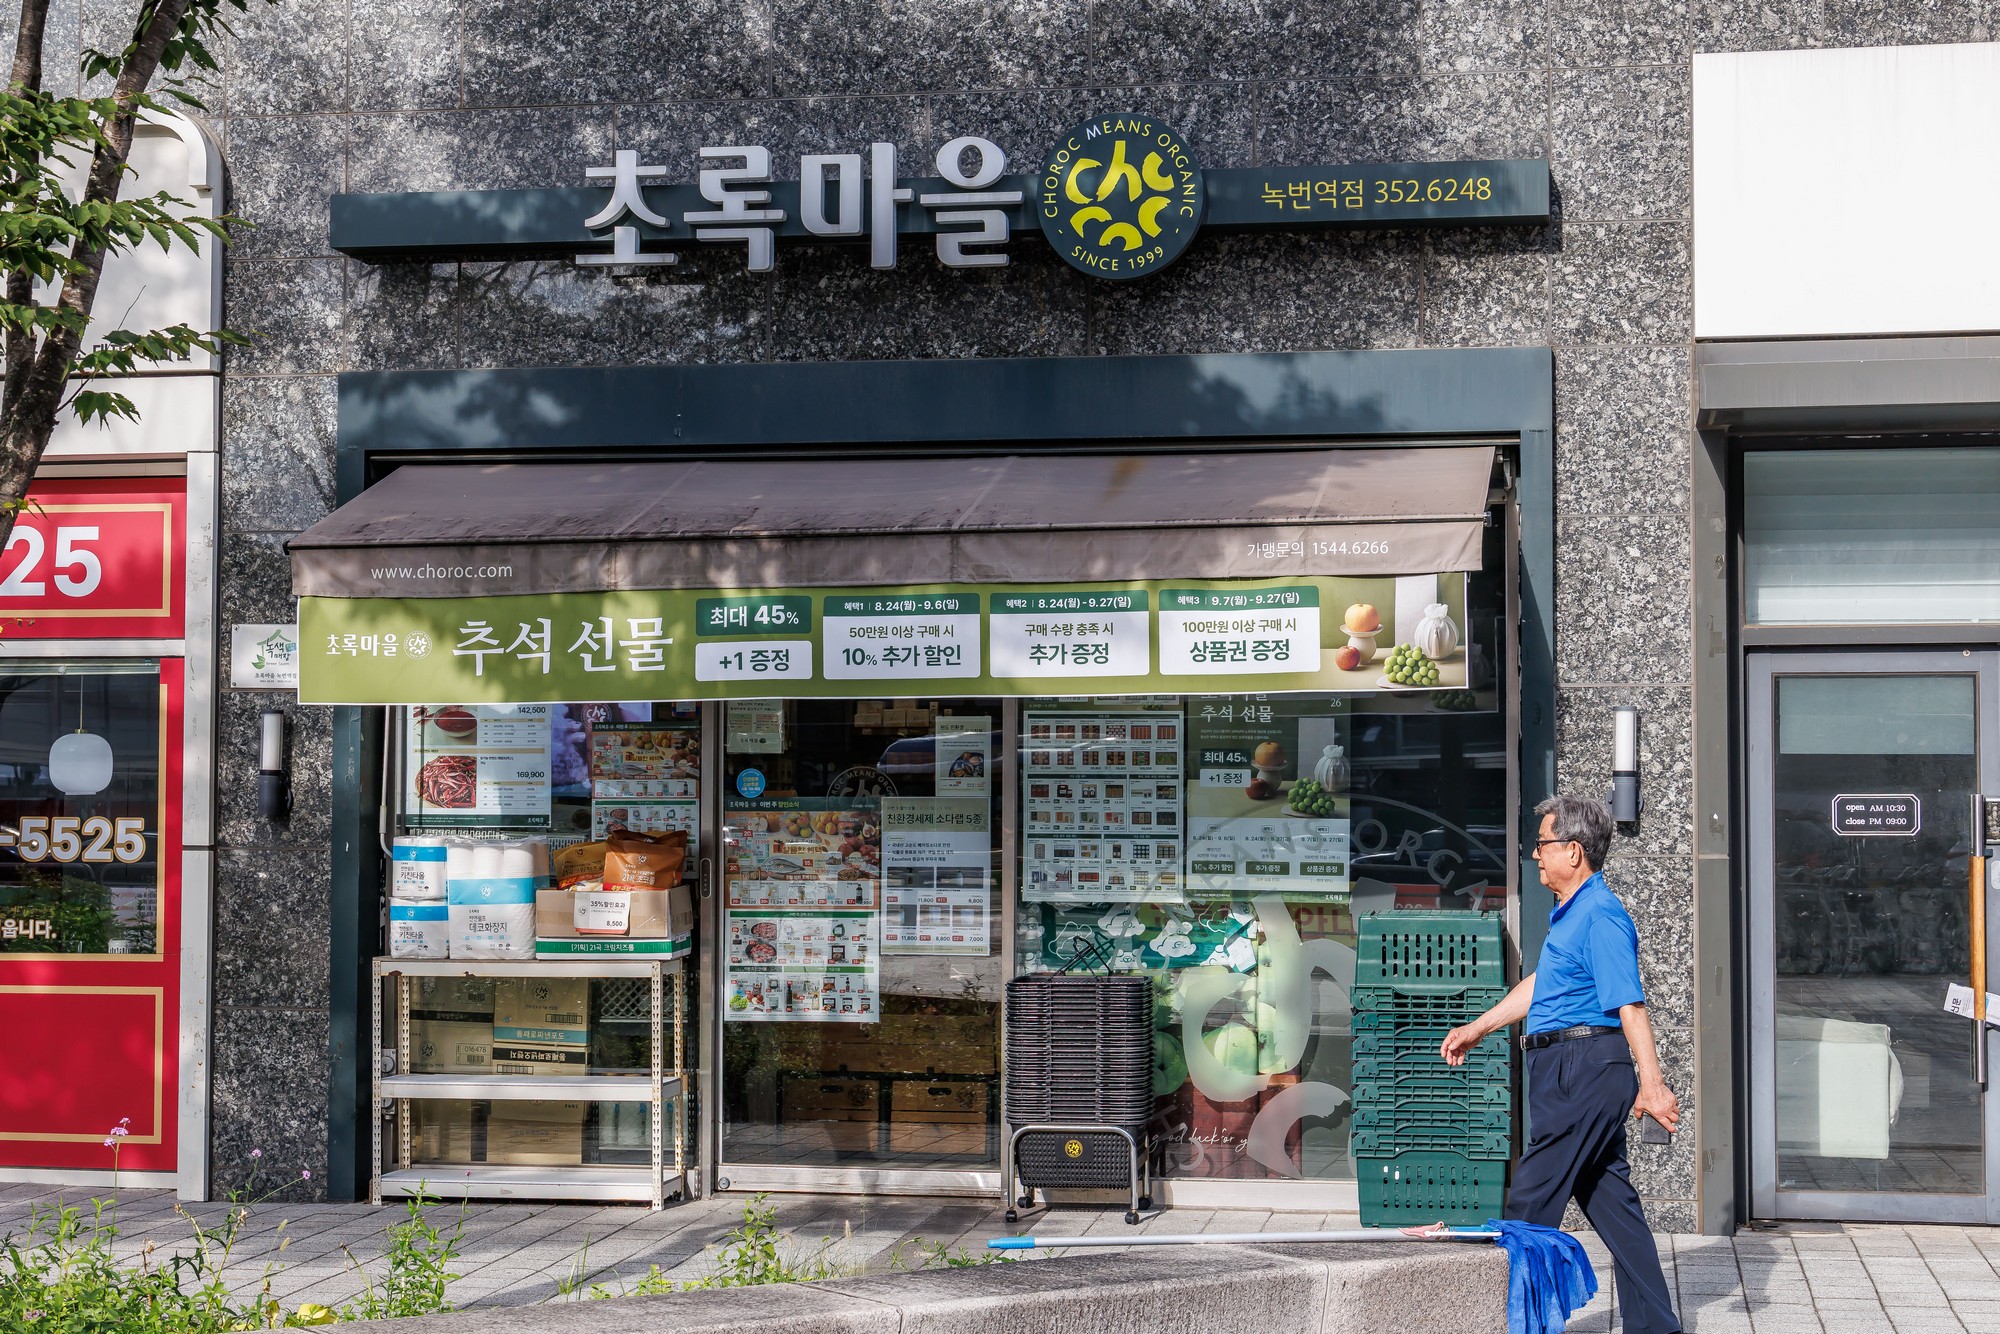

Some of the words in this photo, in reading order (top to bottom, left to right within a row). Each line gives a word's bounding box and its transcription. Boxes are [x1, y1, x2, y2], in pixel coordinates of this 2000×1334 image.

[1044, 138, 1080, 217] CHOROC
[1086, 119, 1152, 141] MEANS
[1158, 133, 1196, 218] ORGANIC
[1261, 179, 1364, 210] 녹번역점
[1374, 177, 1491, 204] 352.6248
[576, 136, 1023, 273] 초록마을
[1071, 245, 1119, 271] SINCE
[1128, 246, 1164, 270] 1999
[1247, 541, 1304, 559] 가맹문의
[1312, 540, 1389, 555] 1544.6266
[371, 562, 513, 579] www.choroc.com
[710, 606, 747, 628] 최대
[754, 604, 799, 625] 45%
[849, 626, 889, 639] 50만원
[891, 625, 914, 639] 이상
[917, 625, 941, 638] 구매
[943, 624, 954, 638] 시
[1025, 623, 1048, 637] 구매
[1050, 622, 1073, 637] 수량
[1076, 622, 1099, 636] 충족
[1102, 622, 1114, 636] 시
[1182, 619, 1229, 634] 100만원
[1232, 618, 1255, 633] 이상
[1258, 618, 1282, 633] 구매
[1285, 618, 1297, 632] 시
[326, 633, 399, 657] 초록마을
[452, 616, 552, 677] 추석
[567, 616, 673, 673] 선물
[1189, 640, 1247, 663] 상품권
[1251, 638, 1290, 661] 증정
[719, 651, 743, 671] +1
[750, 648, 790, 672] 증정
[842, 648, 878, 667] 10%
[882, 645, 920, 667] 추가
[924, 645, 962, 667] 할인
[1029, 643, 1067, 665] 추가
[1071, 642, 1109, 665] 증정
[1330, 697, 1342, 708] 26
[518, 706, 546, 715] 142,500
[1200, 704, 1233, 723] 추석
[1240, 704, 1274, 723] 선물
[1204, 751, 1225, 764] 최대
[1226, 752, 1248, 763] 45%
[517, 771, 545, 779] 169,900
[1208, 773, 1221, 783] +1
[1223, 772, 1243, 784] 증정
[1846, 804, 1865, 812] open
[1869, 804, 1883, 812] AM
[1886, 804, 1906, 812] 10:30
[887, 813, 933, 825] 친환경세제
[936, 813, 964, 825] 소다랩
[966, 813, 982, 825] 5종
[1845, 817, 1866, 825] close
[1886, 817, 1907, 825] 09:00
[400, 871, 425, 880] 키친타올
[1208, 864, 1220, 872] 추가
[1221, 864, 1234, 872] 할인
[1255, 865, 1268, 873] 추가
[1268, 865, 1281, 873] 증정
[1306, 865, 1325, 873] 상품권
[1326, 865, 1338, 873] 증정
[399, 931, 424, 939] 키친타올
[469, 922, 507, 933] 데코화장지
